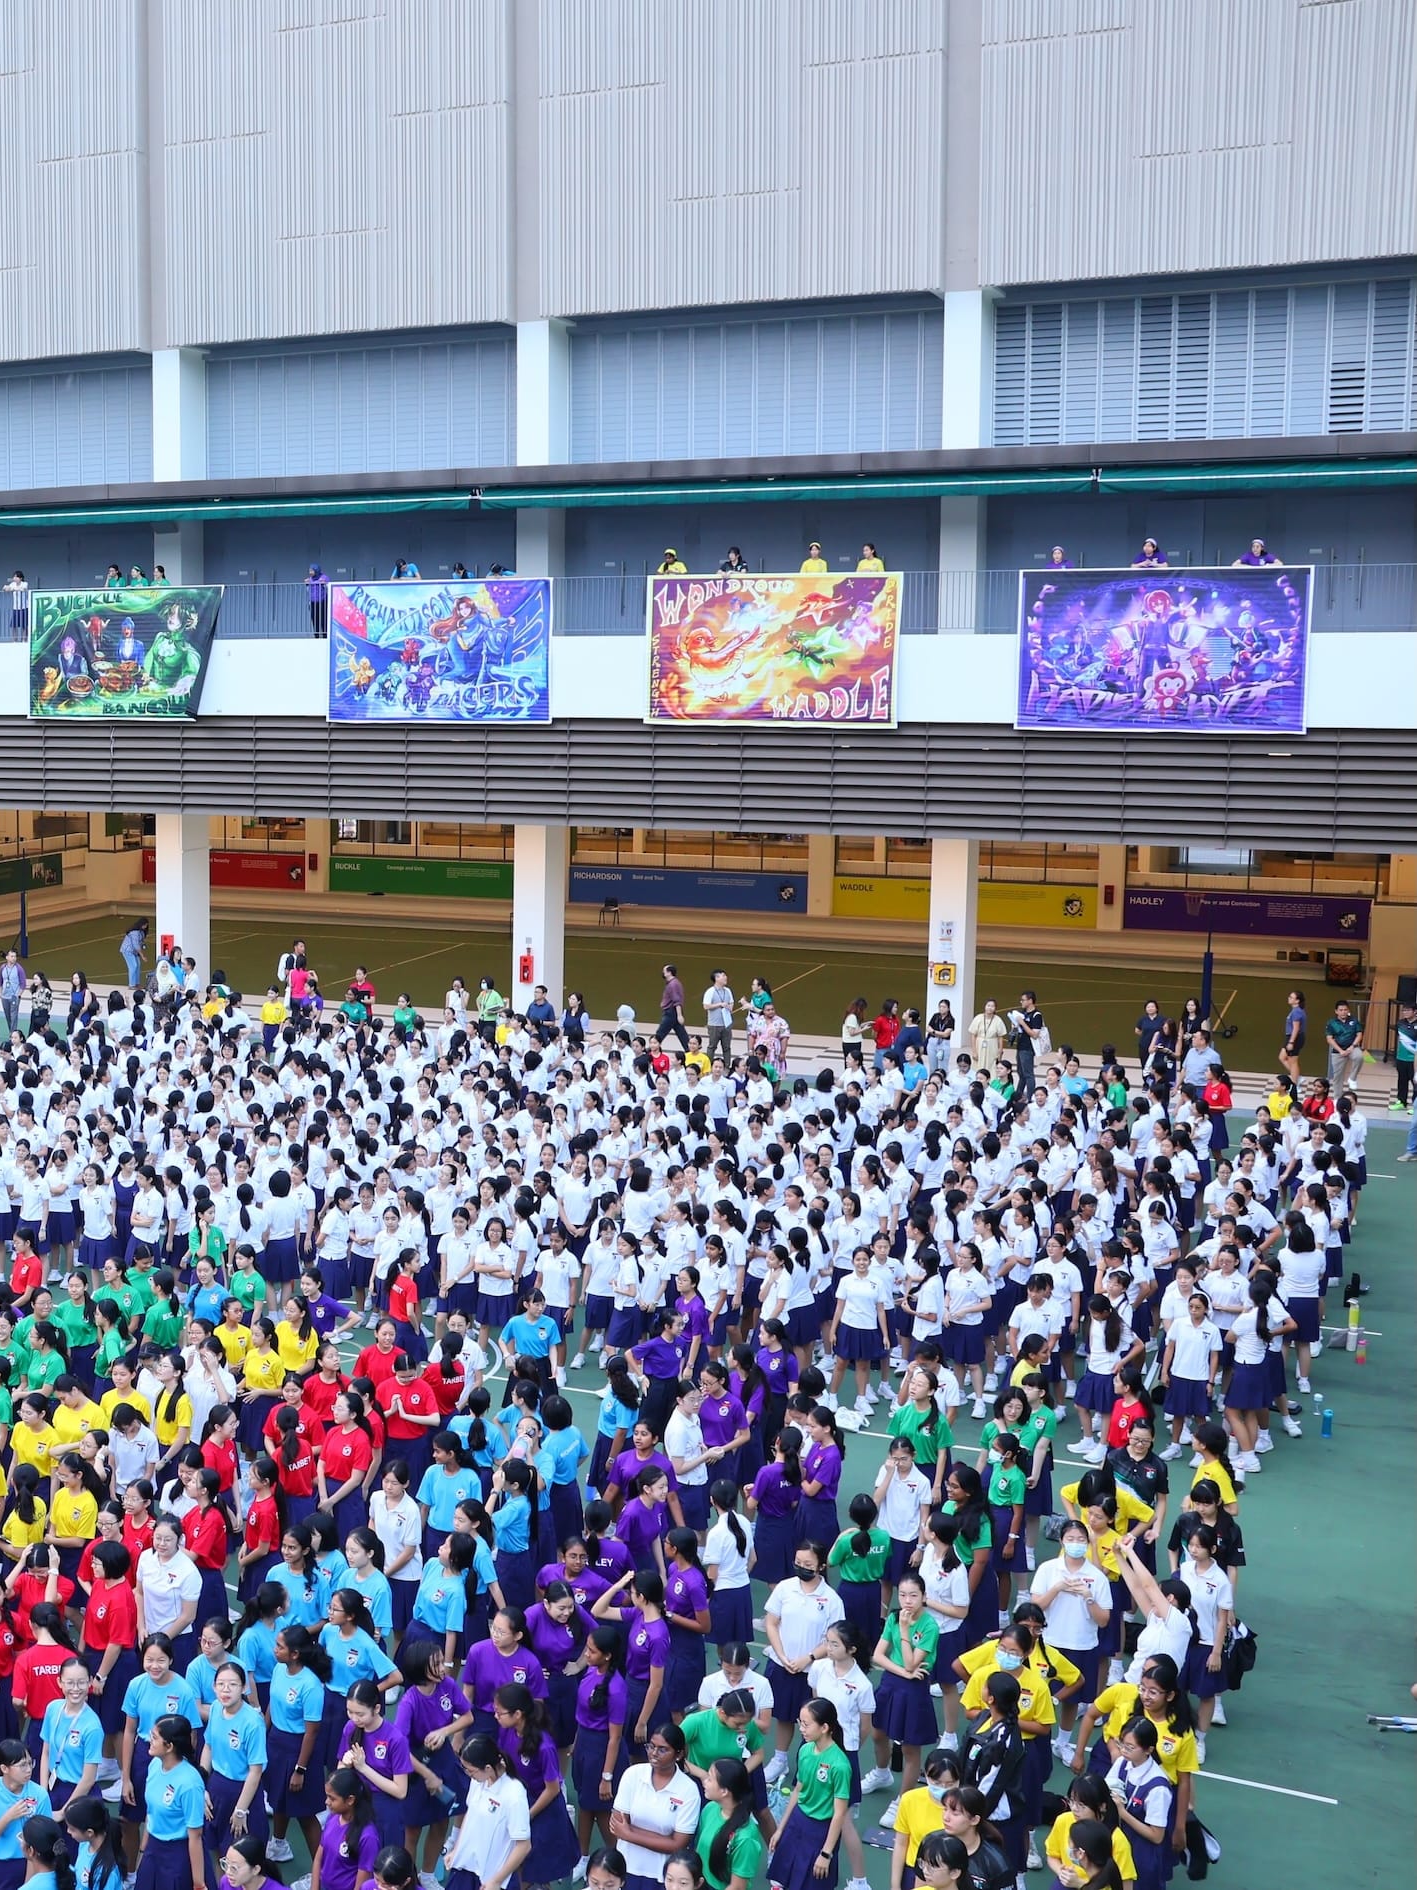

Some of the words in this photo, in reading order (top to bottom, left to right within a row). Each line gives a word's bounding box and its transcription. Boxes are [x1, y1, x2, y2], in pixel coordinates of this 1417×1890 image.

[35, 592, 123, 636] BUCKLE
[349, 585, 456, 633] RICHARDSON
[655, 579, 796, 627] WONDROUS
[884, 579, 896, 649] PRIDE
[650, 633, 661, 717] STRENGTH
[769, 665, 890, 719] WADDLE
[102, 693, 191, 714] BANQU
[335, 862, 361, 871] BUCKLE
[573, 871, 622, 881] RICHARDSON
[839, 882, 874, 892] WADDLE
[1129, 896, 1164, 905] HADLEY
